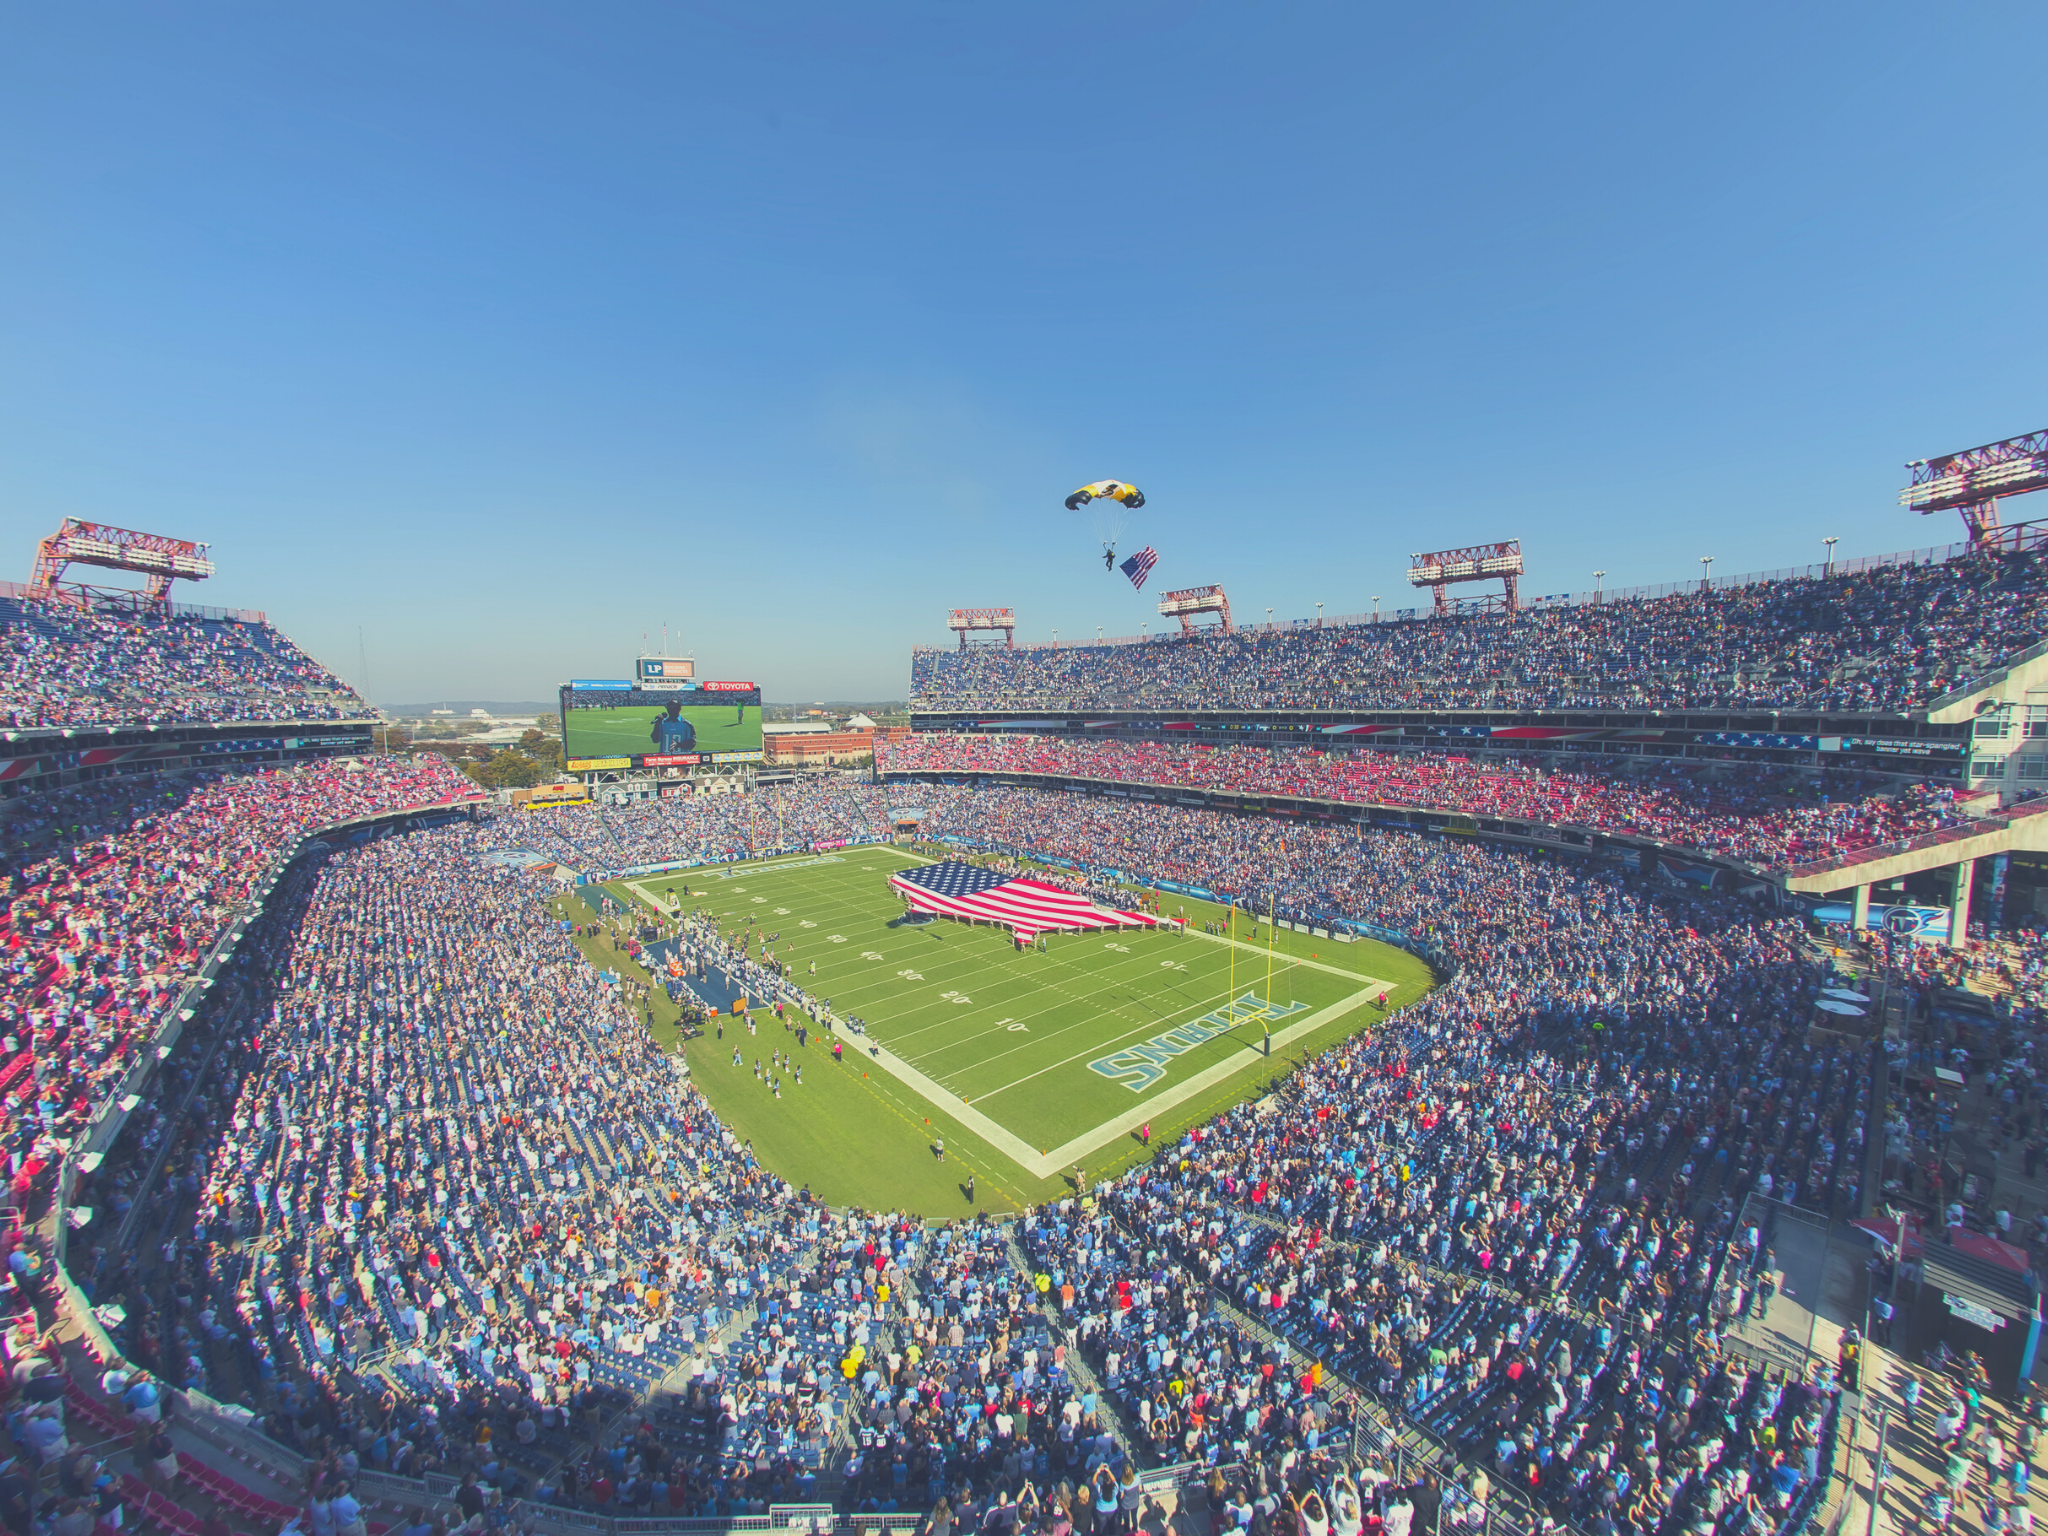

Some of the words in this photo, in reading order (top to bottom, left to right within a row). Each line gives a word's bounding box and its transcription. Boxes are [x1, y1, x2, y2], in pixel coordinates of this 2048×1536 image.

[648, 664, 662, 673] LP
[827, 934, 848, 943] 50
[860, 951, 883, 961] 40
[897, 969, 922, 981] 30
[940, 991, 970, 1004] 20
[995, 1018, 1026, 1032] 10
[1086, 989, 1313, 1094] TITANS
